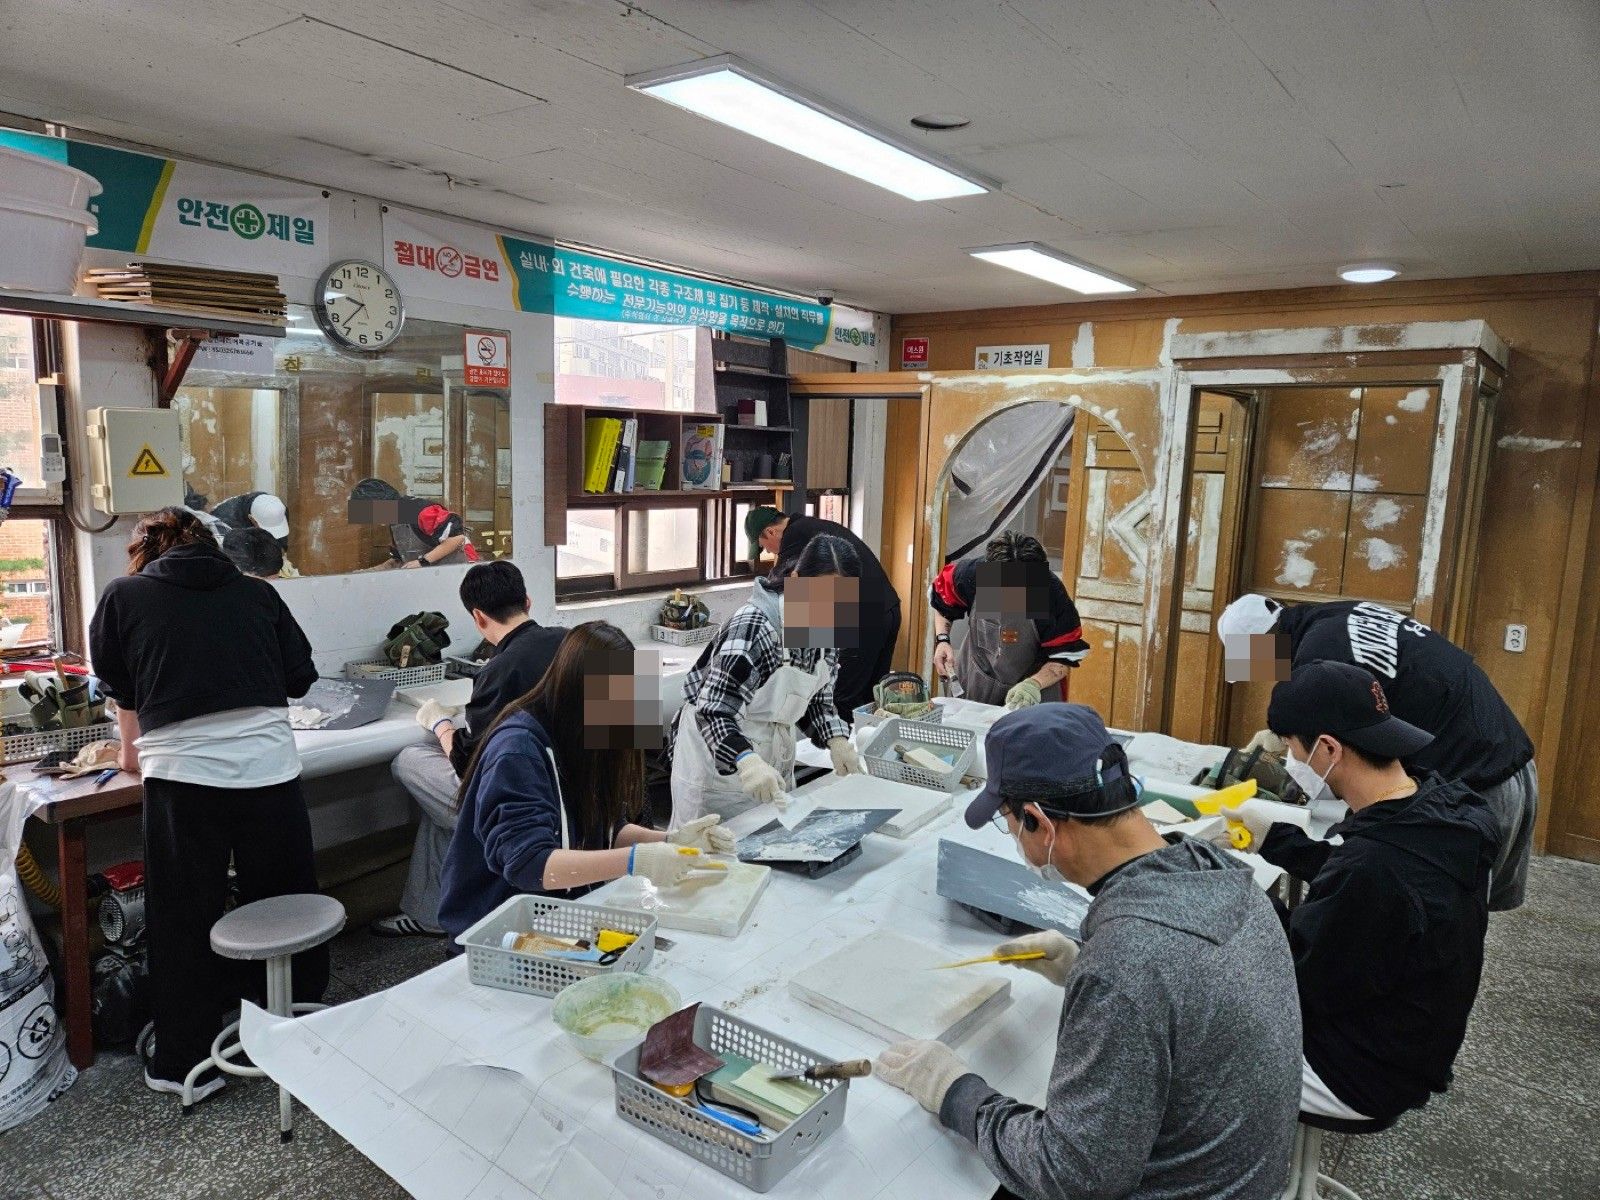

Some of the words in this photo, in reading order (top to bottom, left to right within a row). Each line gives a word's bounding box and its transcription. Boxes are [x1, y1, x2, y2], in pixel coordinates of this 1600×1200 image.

[177, 198, 229, 231] 안전
[266, 212, 314, 245] 제일
[394, 241, 435, 270] 절대
[465, 255, 499, 282] 금연
[342, 268, 352, 279] 11
[356, 266, 368, 278] 12
[330, 278, 343, 289] 10
[569, 262, 607, 285] 건축에
[610, 270, 645, 291] 필요한
[648, 278, 670, 297] 각종
[706, 291, 716, 306] 및
[742, 298, 749, 312] 등
[385, 288, 394, 298] 2
[390, 306, 397, 316] 3
[567, 282, 616, 304] 수행하는
[730, 313, 765, 332] 목적으로
[332, 313, 340, 322] 8
[344, 326, 352, 336] 7
[385, 321, 394, 330] 4
[359, 334, 368, 344] 6
[375, 331, 384, 340] 5
[835, 327, 850, 343] 안전
[860, 332, 875, 346] 제일
[993, 350, 1043, 366] 기초작업실
[1347, 613, 1399, 679] UNDER
